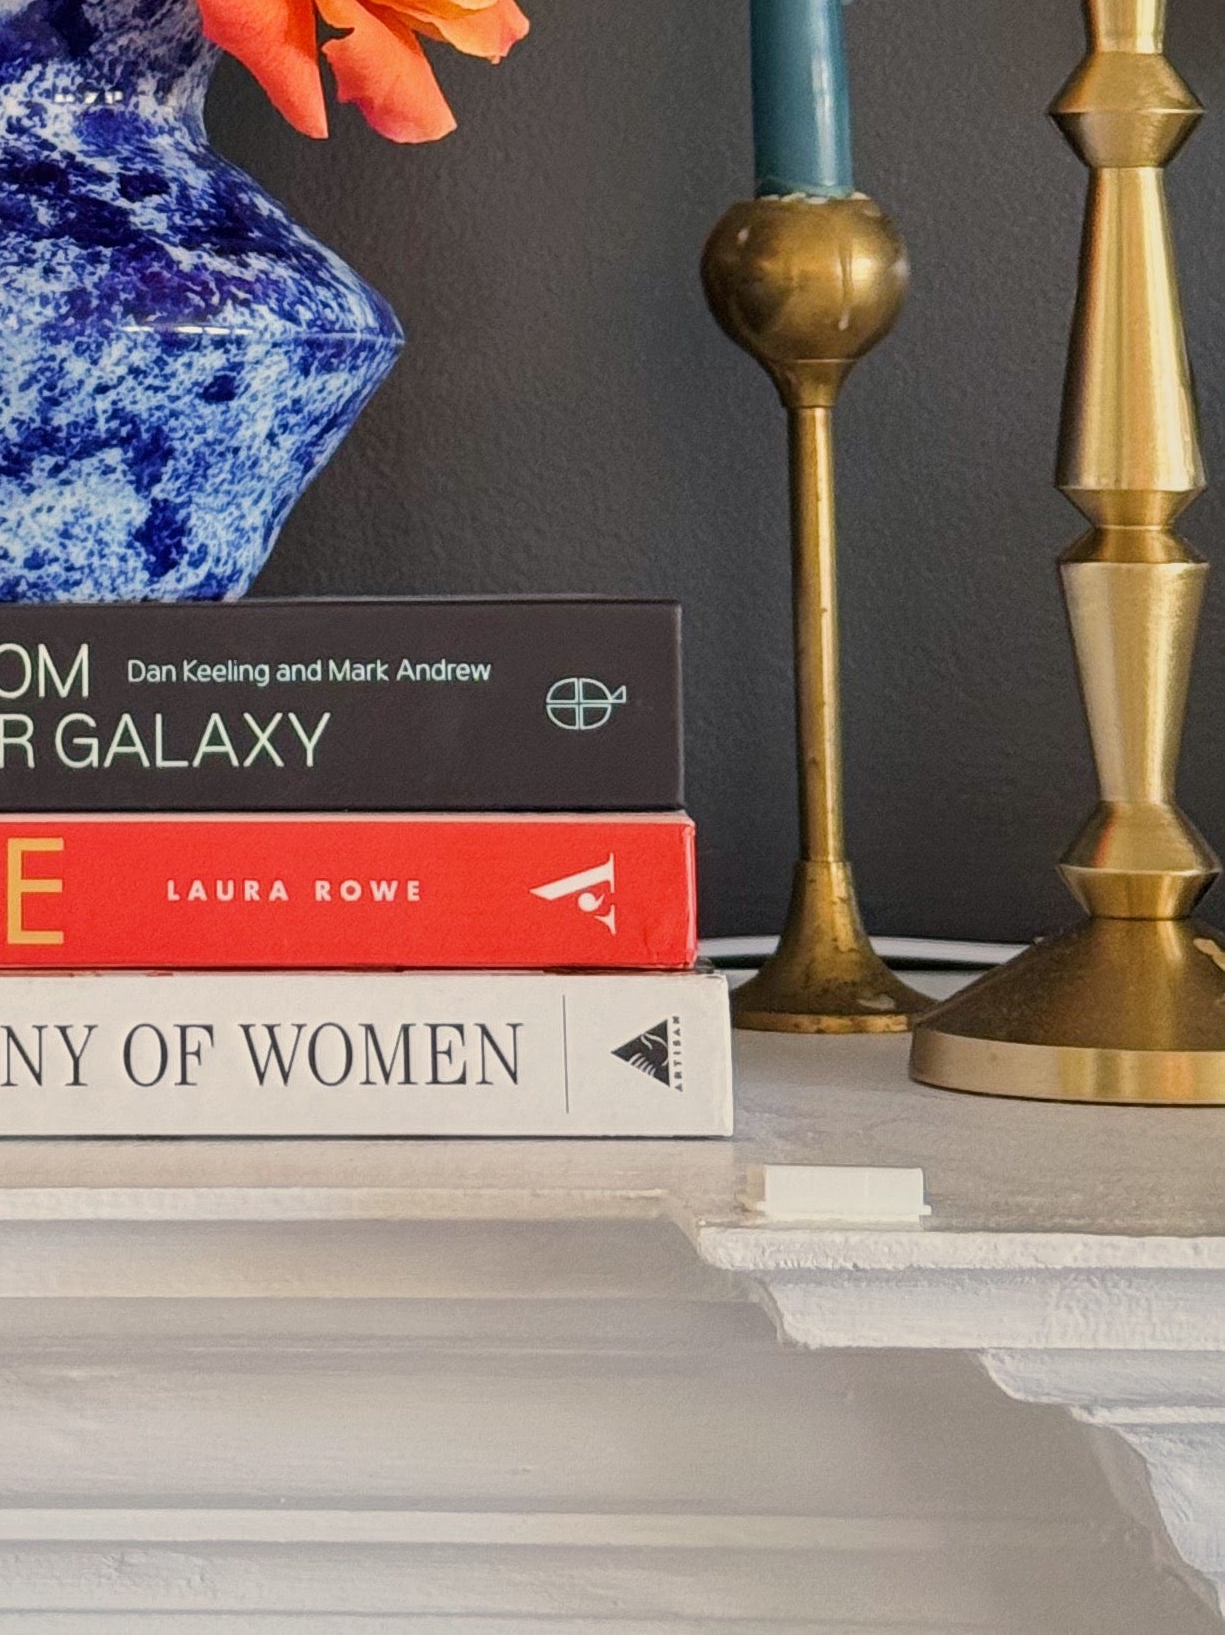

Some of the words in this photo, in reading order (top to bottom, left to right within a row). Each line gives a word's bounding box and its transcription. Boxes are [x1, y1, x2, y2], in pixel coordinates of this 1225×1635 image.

[127, 659, 177, 683] Dan
[182, 659, 270, 687] Keeling
[275, 659, 322, 682] and
[328, 658, 390, 682] Mark
[396, 658, 492, 682] Andrew
[54, 712, 331, 769] GALAXY
[167, 880, 289, 901] LAURA
[315, 879, 420, 902] ROWE
[123, 1023, 214, 1087] OF
[239, 1022, 524, 1087] WOMEN
[672, 1015, 684, 1092] ARTISAN
